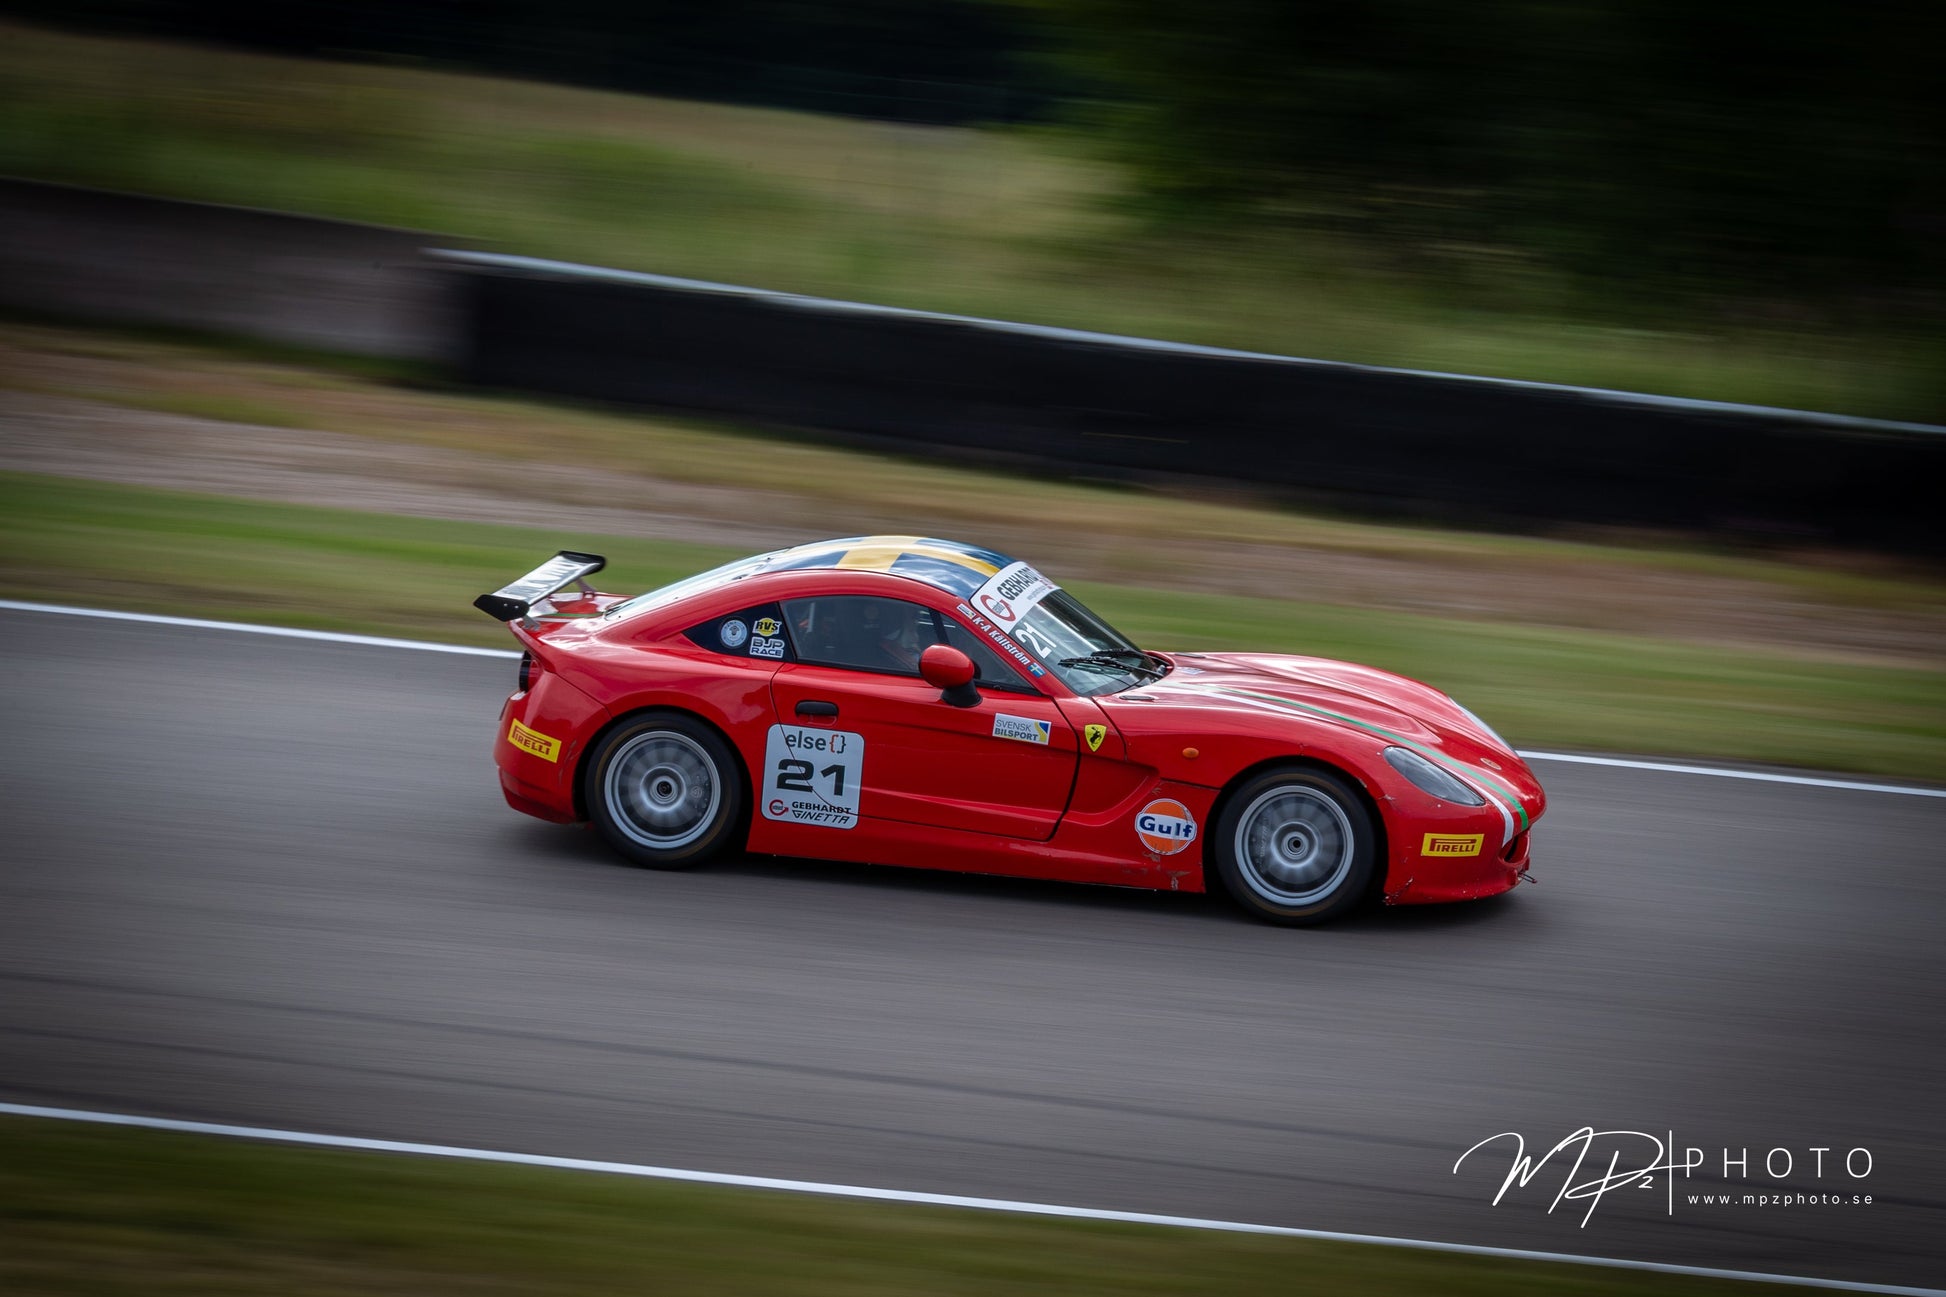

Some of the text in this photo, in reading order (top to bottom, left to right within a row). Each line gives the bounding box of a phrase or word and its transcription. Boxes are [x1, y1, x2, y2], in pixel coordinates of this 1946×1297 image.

[755, 621, 780, 631] RVS
[752, 637, 785, 649] BJP
[973, 617, 1031, 666] K-A Källström
[1015, 622, 1057, 659] 21
[751, 647, 782, 657] RACE
[996, 719, 1032, 732] SVENSK
[512, 725, 552, 755] PIRELLI
[994, 728, 1039, 741] BILSPORT
[776, 758, 846, 797] 21
[792, 801, 852, 815] GEBHARDT
[792, 810, 850, 825] GINETTA
[1139, 815, 1193, 838] Gulf
[1429, 838, 1477, 852] PIRELLI
